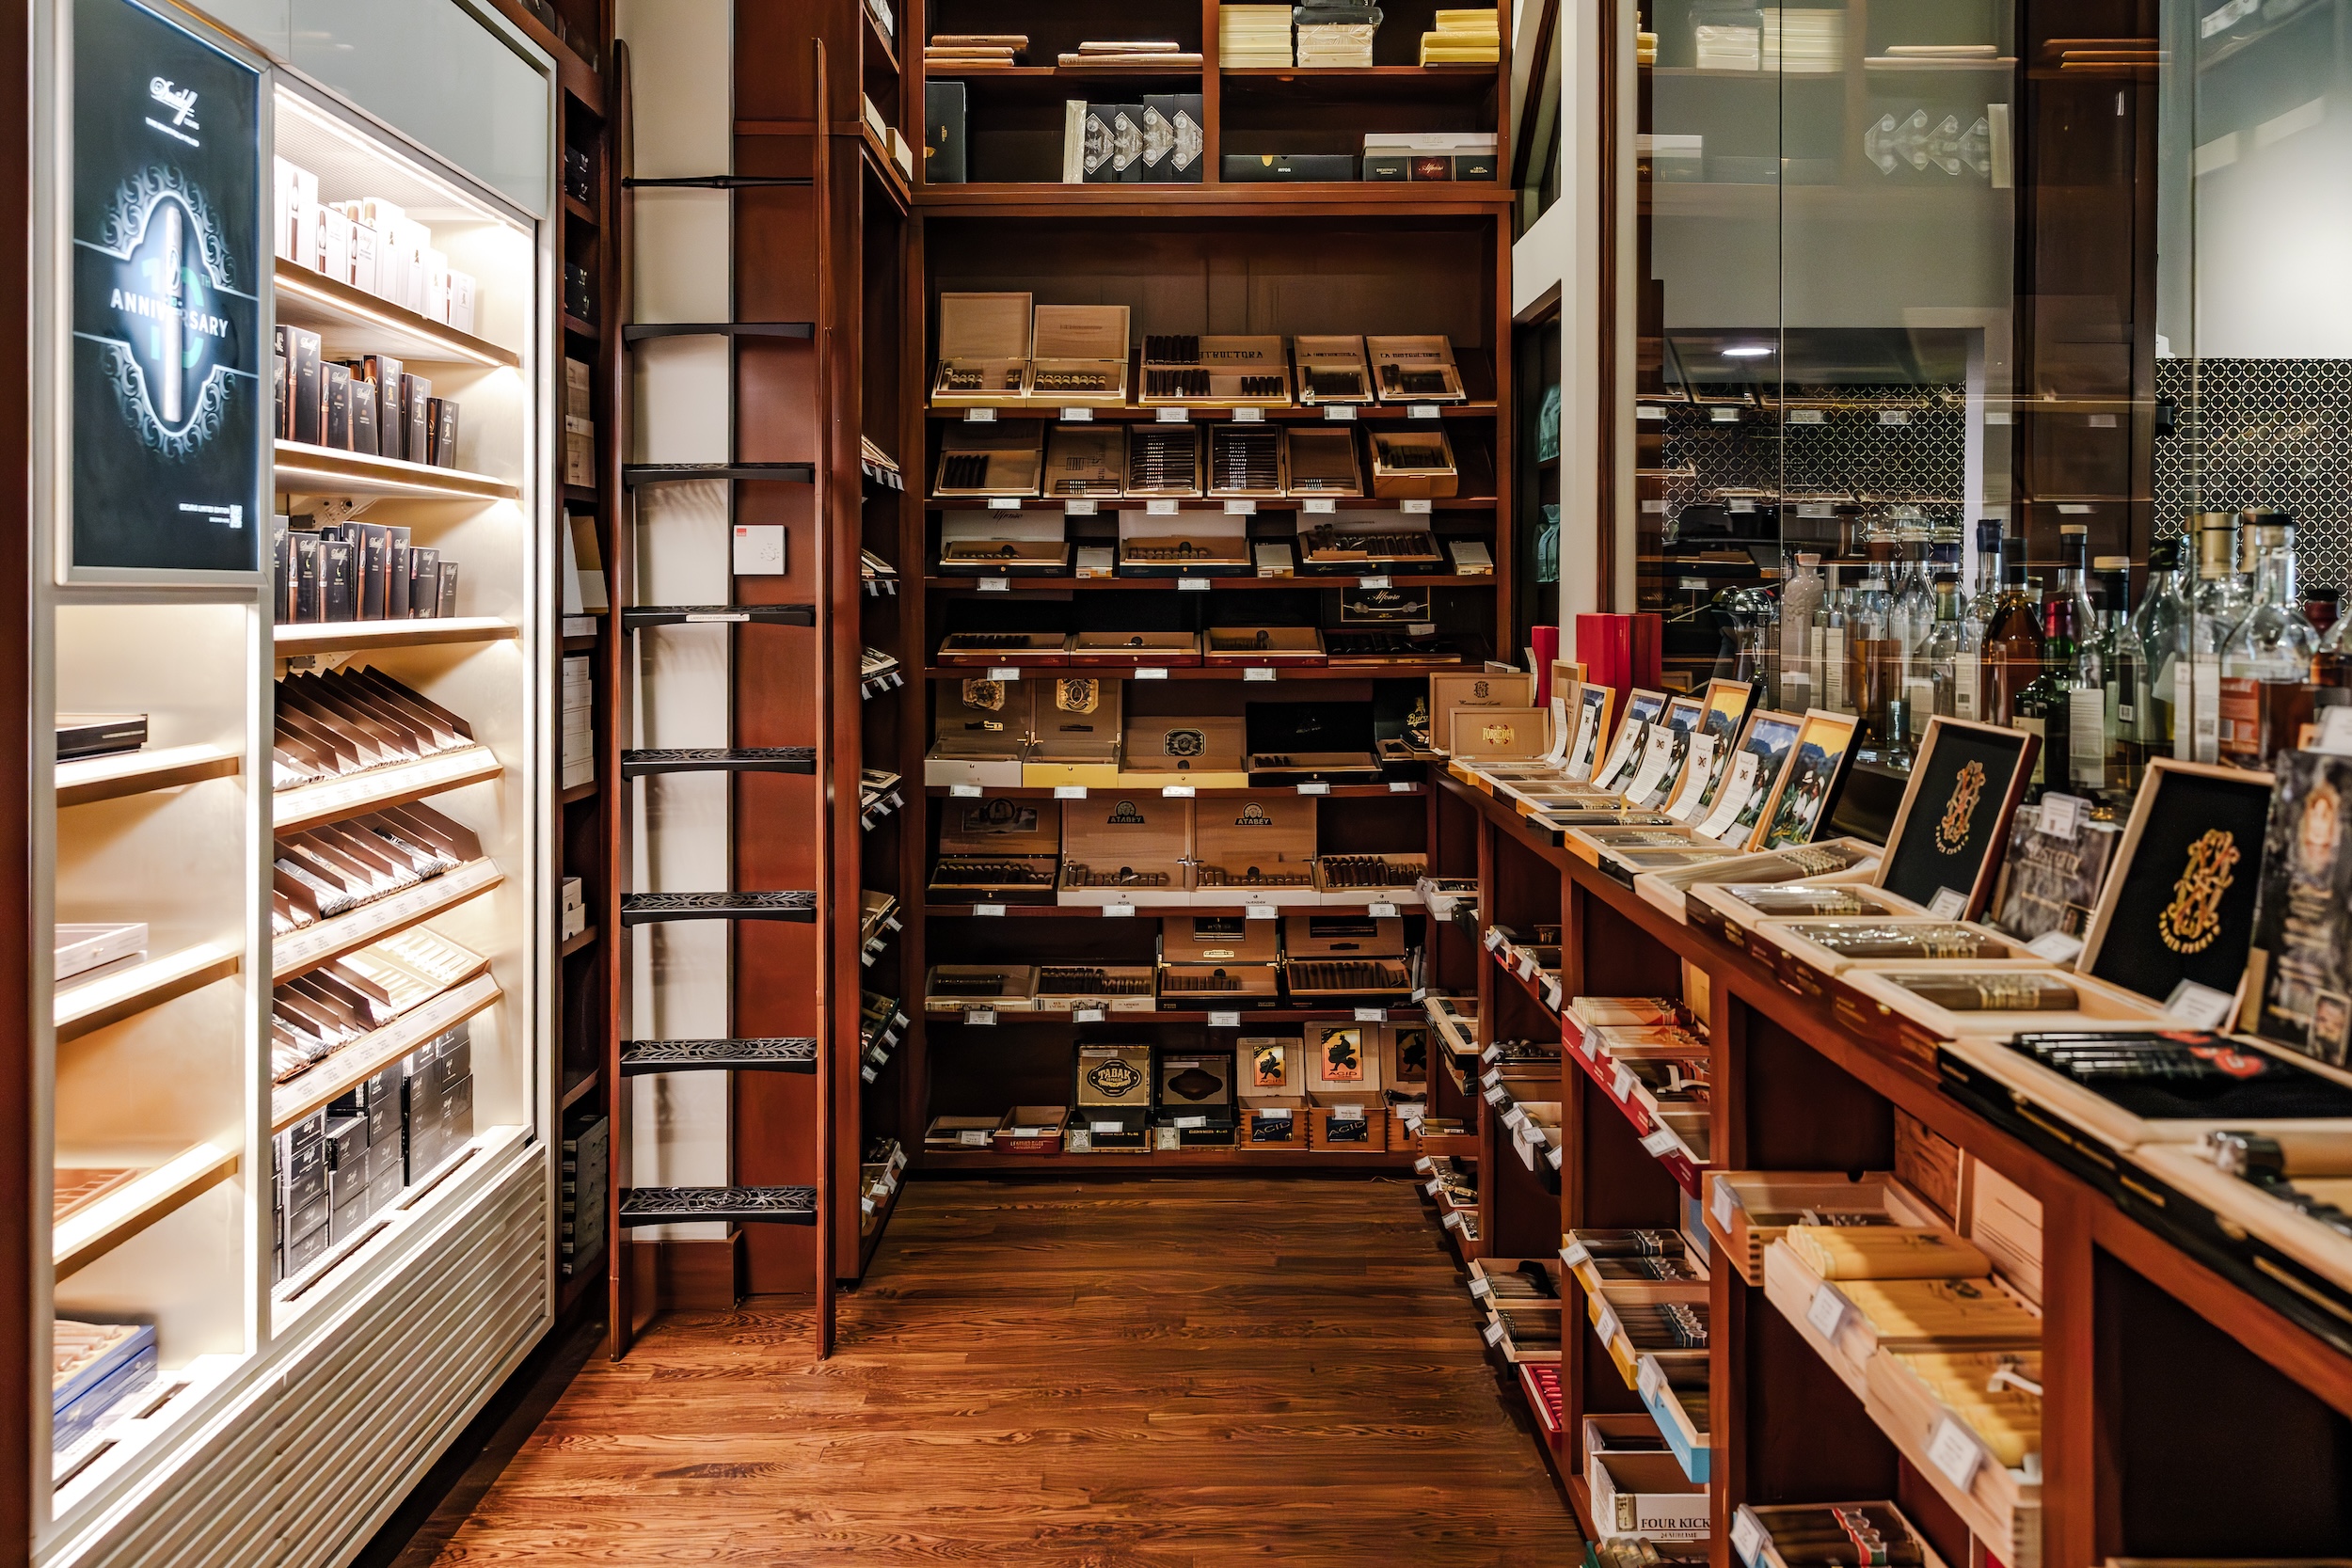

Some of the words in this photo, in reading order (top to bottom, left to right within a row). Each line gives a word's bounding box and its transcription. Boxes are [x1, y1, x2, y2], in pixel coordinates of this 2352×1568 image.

[110, 288, 229, 329] ANNIVRSARY
[1098, 1068, 1132, 1080] TABAK
[1254, 1121, 1291, 1137] ACID
[1328, 1121, 1366, 1137] ACID
[1641, 1518, 1677, 1528] FOUR
